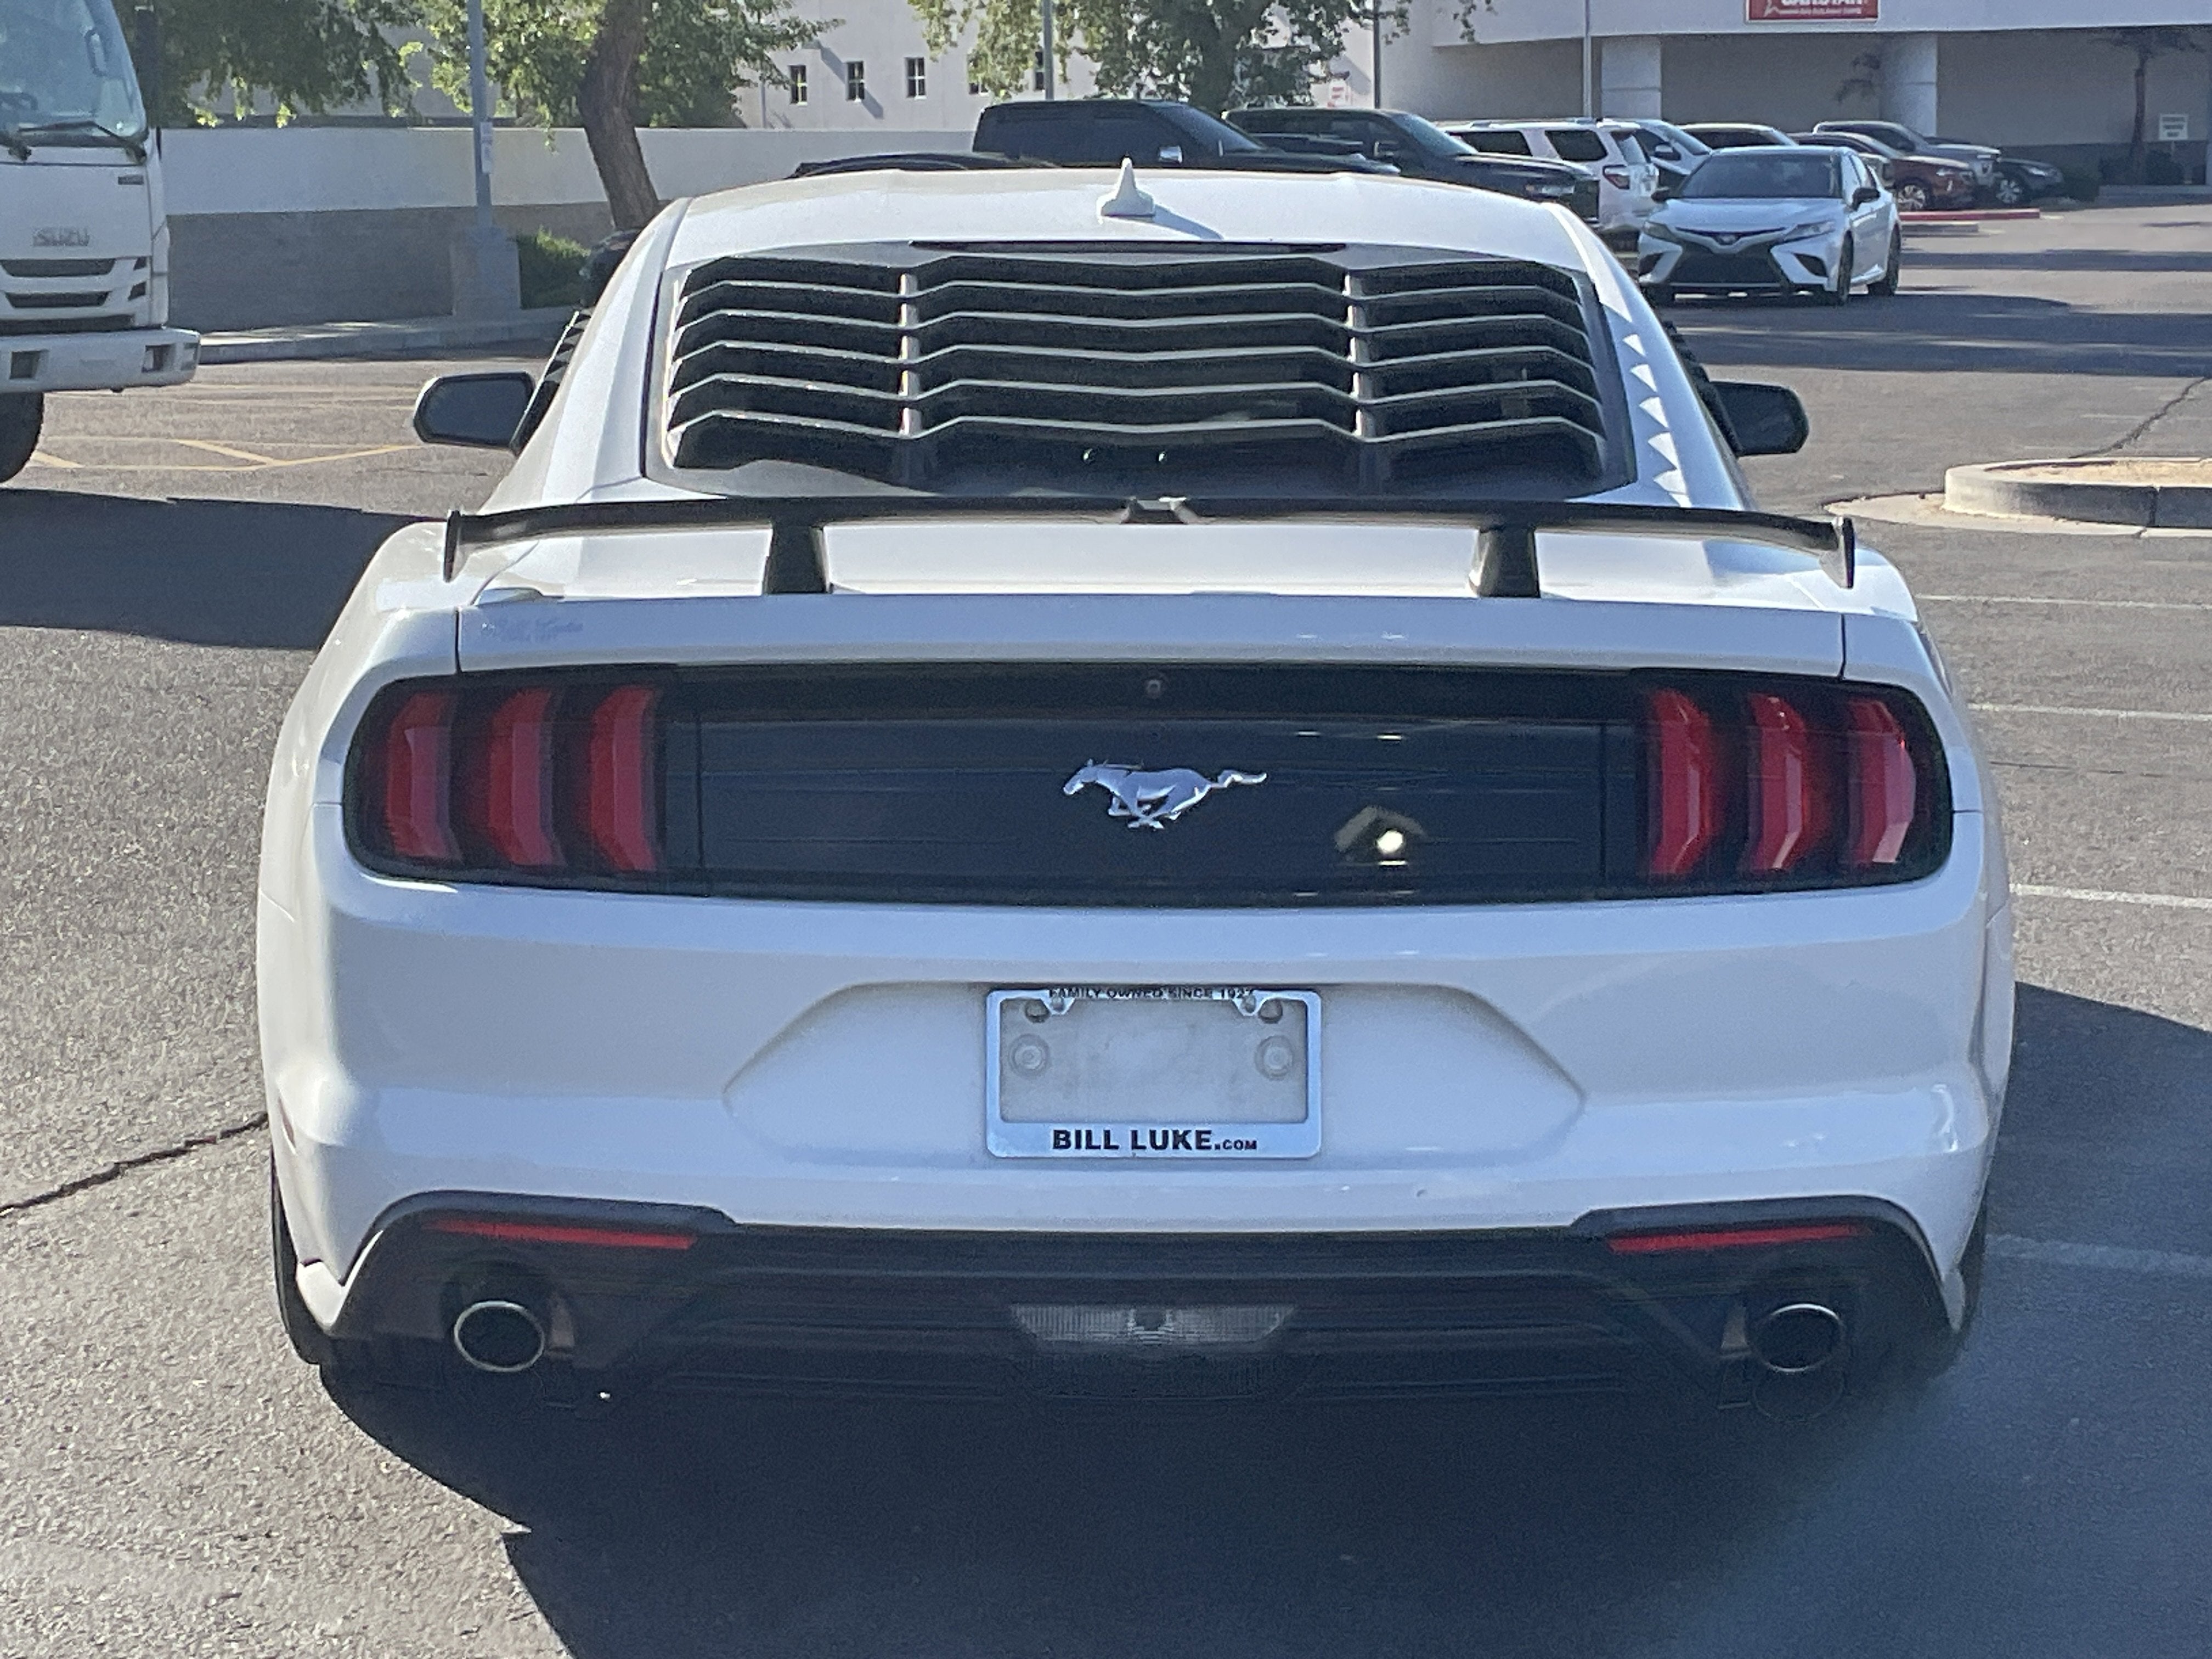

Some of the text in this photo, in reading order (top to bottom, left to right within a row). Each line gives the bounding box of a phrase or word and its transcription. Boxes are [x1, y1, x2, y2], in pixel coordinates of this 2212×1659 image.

[1048, 987, 1102, 998] FAMILY
[1107, 988, 1163, 999] OWNED
[1168, 987, 1213, 1000] SINCE
[1052, 1128, 1120, 1150] BILL
